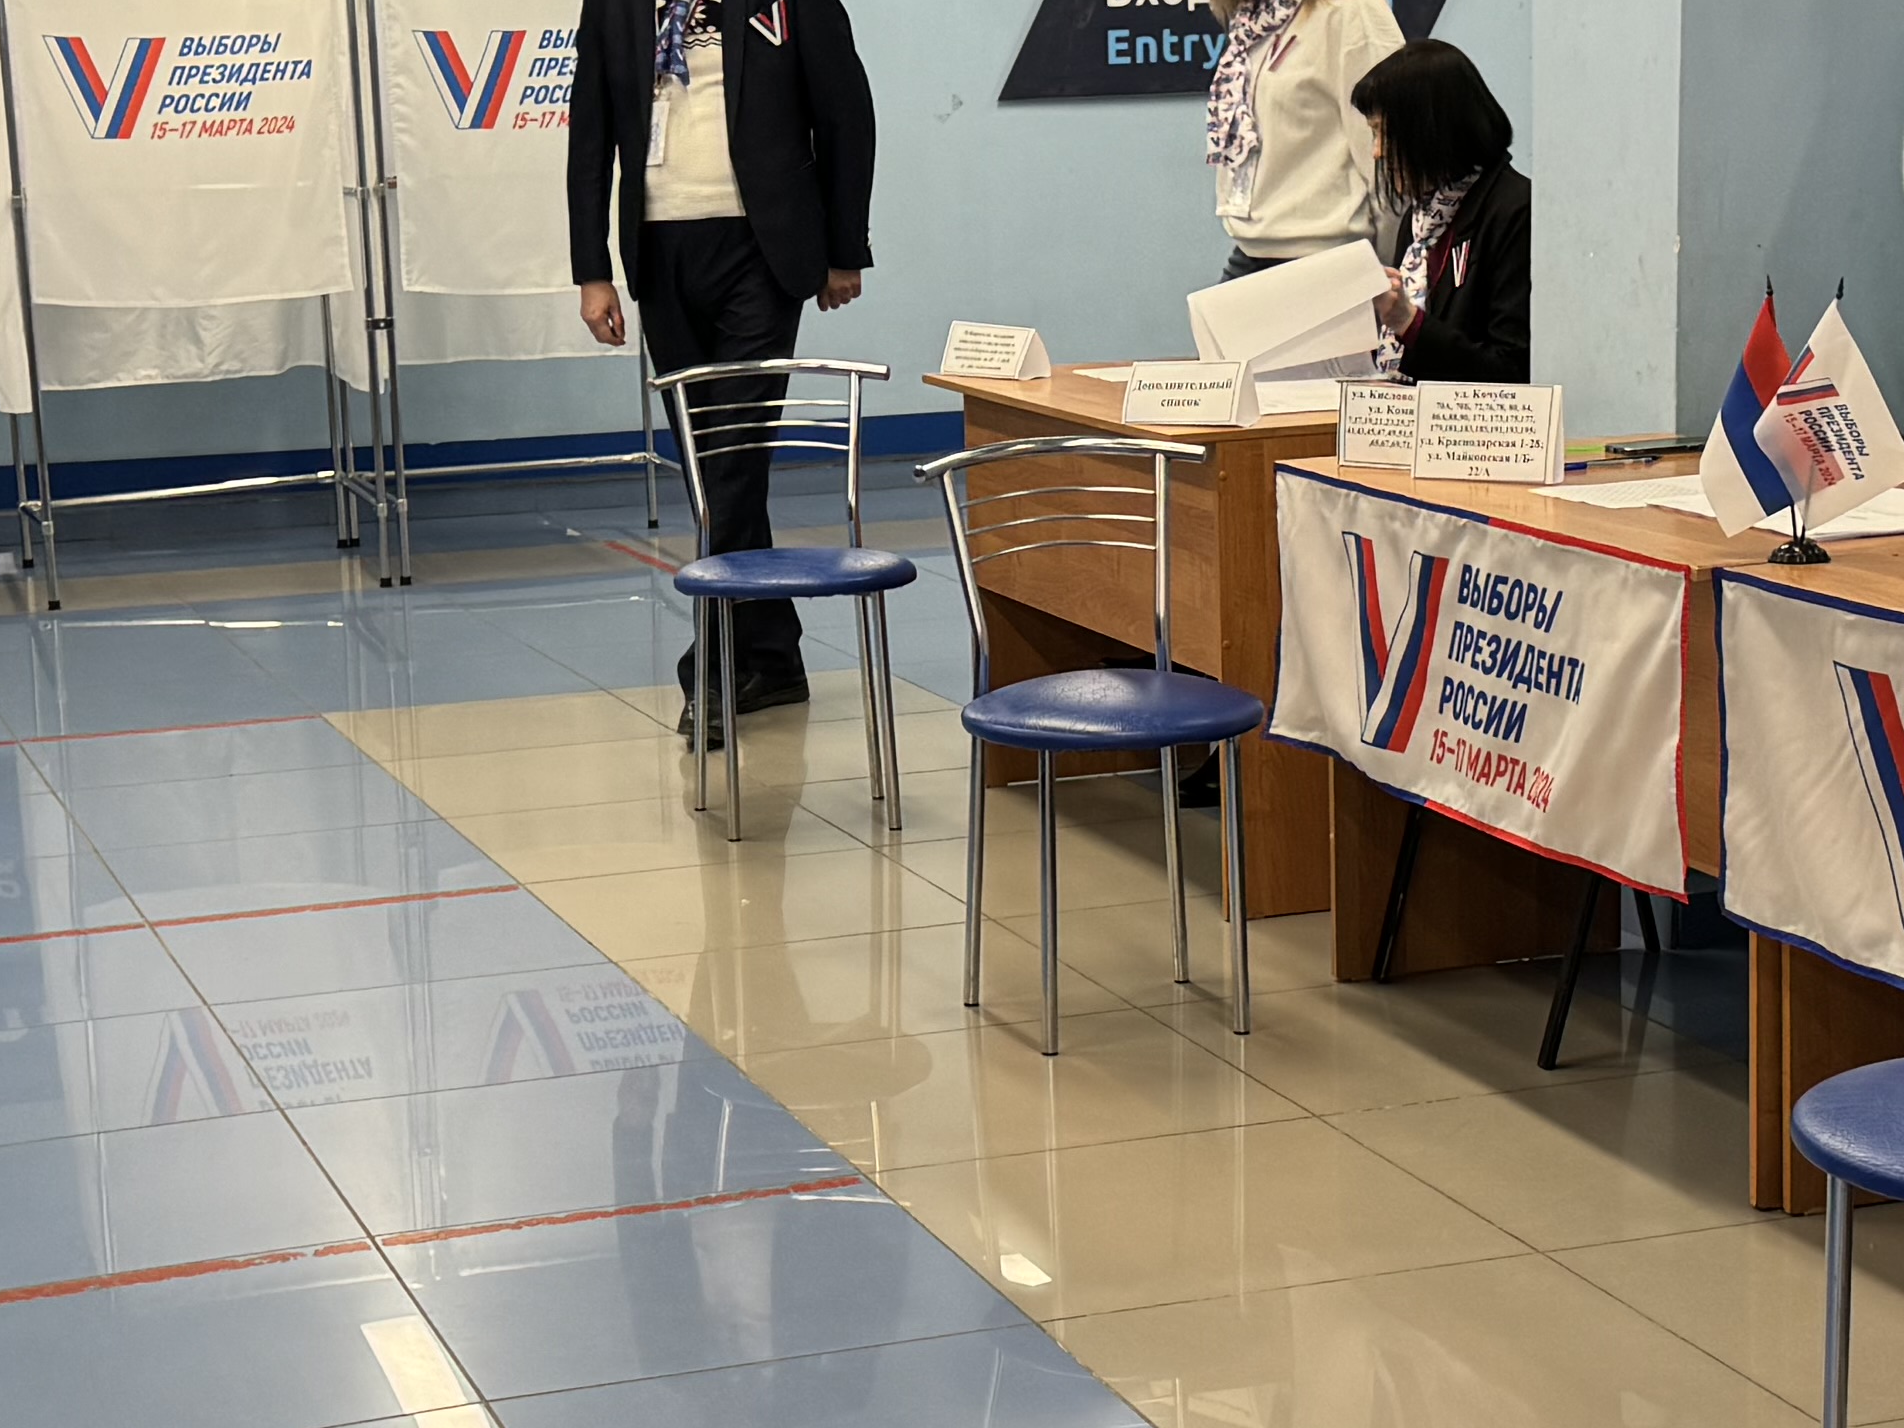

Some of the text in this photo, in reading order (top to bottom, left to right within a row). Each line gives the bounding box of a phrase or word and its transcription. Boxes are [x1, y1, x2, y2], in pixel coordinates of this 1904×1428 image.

[178, 33, 282, 57] ВЫБОРЫ
[1107, 28, 1227, 69] Entry
[167, 59, 313, 87] ПРЕЗИДЕНТА
[157, 91, 253, 115] РОССИИ
[198, 118, 254, 138] МАРТА
[256, 115, 296, 135] 2024
[1160, 398, 1201, 407] список
[1370, 389, 1415, 401] Кислово
[1473, 389, 1517, 402] Кочубея
[1437, 436, 1517, 450] Краснодарская
[1797, 409, 1837, 453] РОССИИ
[1834, 404, 1870, 457] ВЫБОРЫ
[1446, 451, 1511, 463] Майкопская
[1457, 564, 1564, 633] ВЫБОРЫ
[1448, 620, 1586, 705] ПРЕЗИДЕНТА
[1438, 676, 1528, 743] РОССИИ
[1466, 746, 1528, 798] МАРТА
